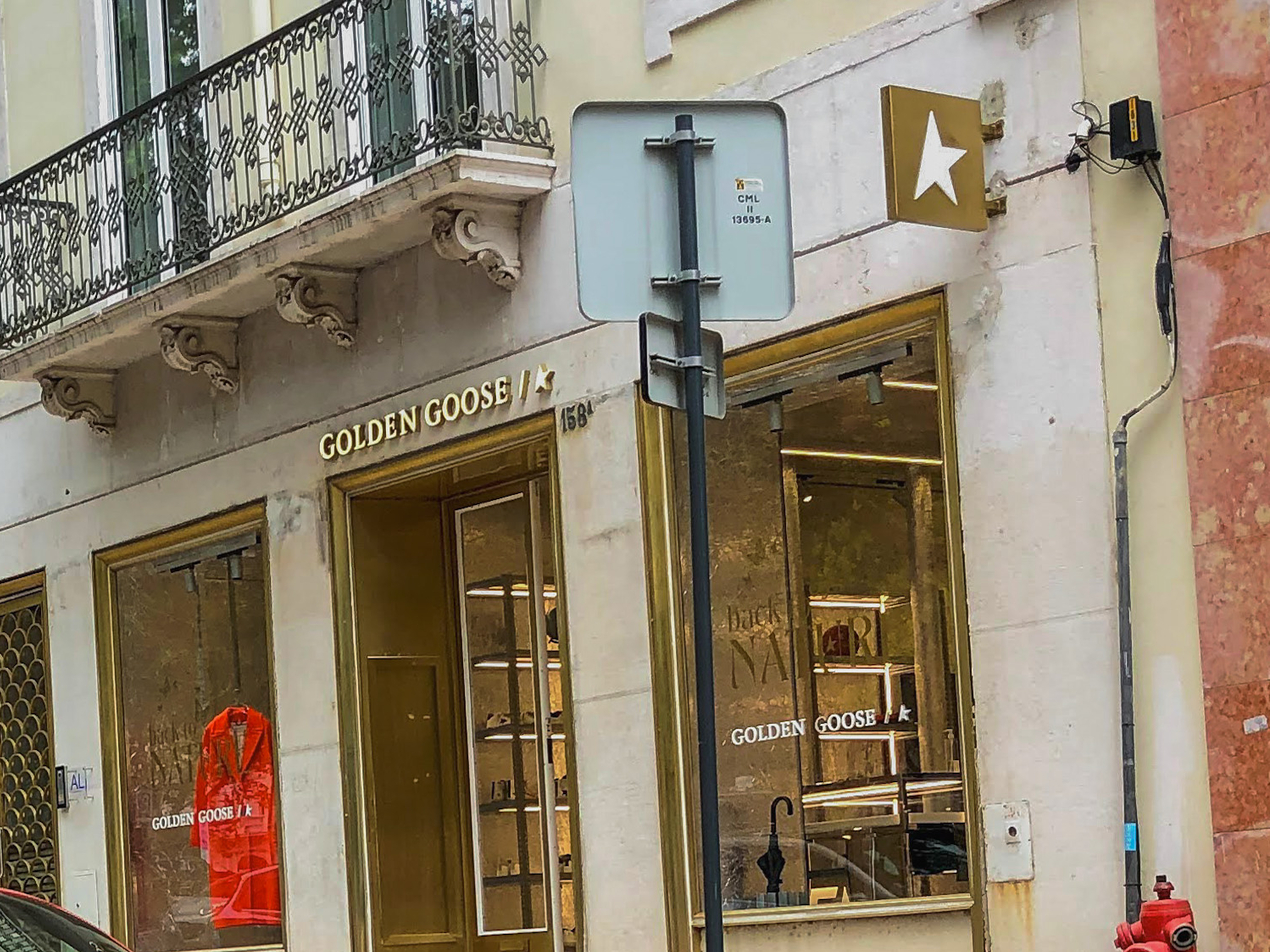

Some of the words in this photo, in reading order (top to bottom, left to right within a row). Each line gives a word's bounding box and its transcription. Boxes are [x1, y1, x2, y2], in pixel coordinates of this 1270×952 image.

[737, 194, 760, 203] CML
[731, 215, 772, 224] 13695-A
[319, 405, 419, 460] GOLDEN
[424, 375, 511, 427] GOOSE
[731, 718, 806, 746] GOLDEN
[814, 708, 877, 733] GOOSE
[70, 773, 85, 791] AL
[152, 812, 195, 831] GOLDEN
[198, 806, 234, 824] GOOSE
